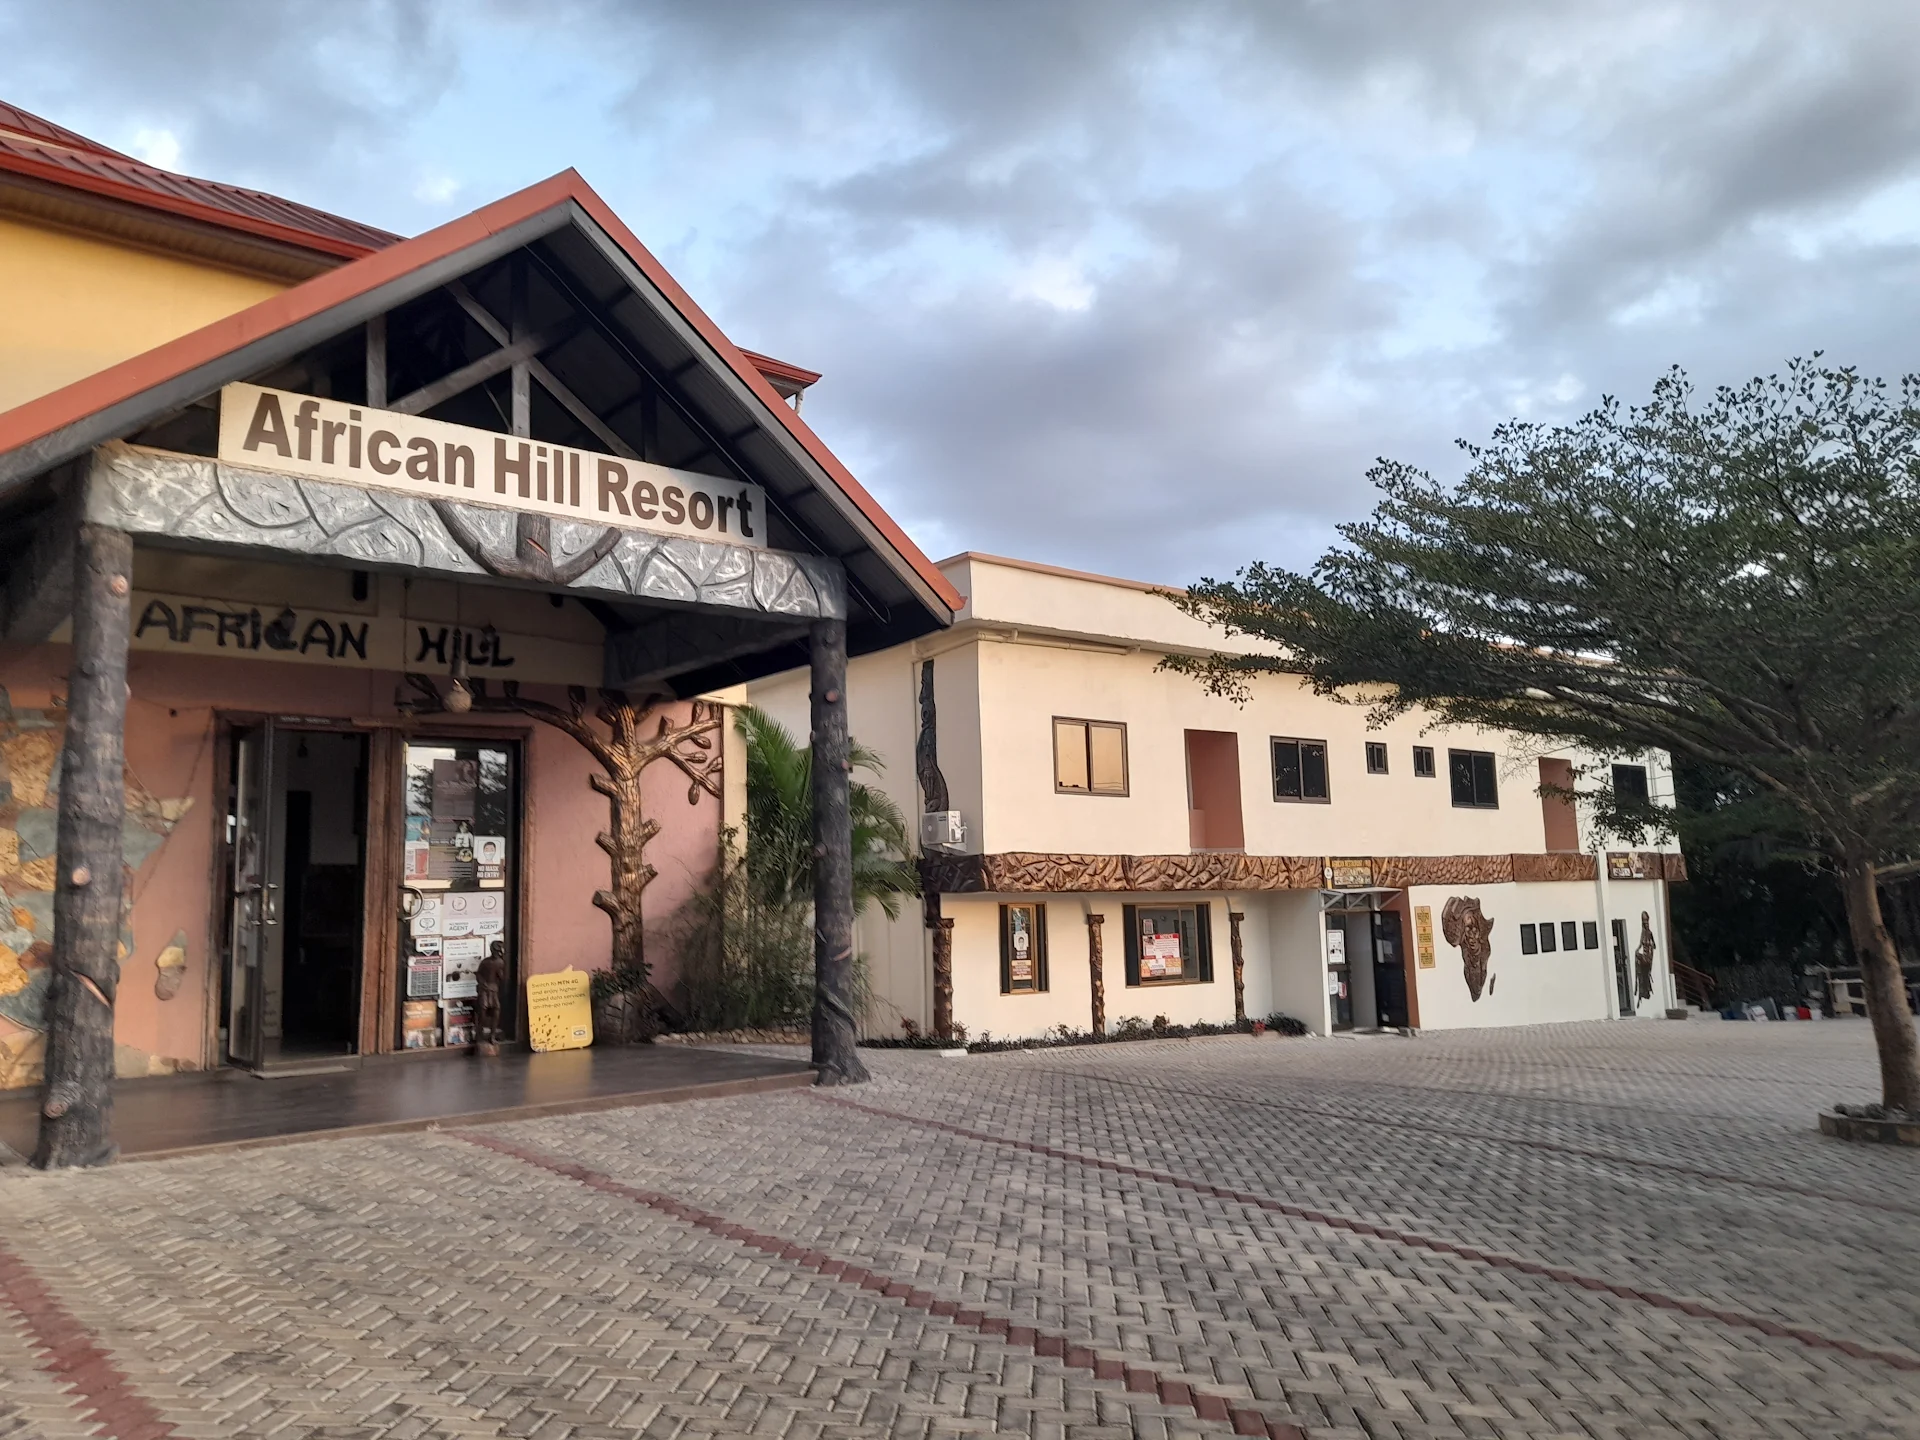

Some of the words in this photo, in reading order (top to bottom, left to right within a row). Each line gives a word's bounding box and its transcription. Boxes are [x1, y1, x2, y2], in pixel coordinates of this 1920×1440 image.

[243, 393, 474, 488] African
[494, 438, 580, 507] Hill
[597, 458, 754, 538] Resort
[135, 600, 368, 660] AFRICAN
[416, 625, 515, 668] HILL
